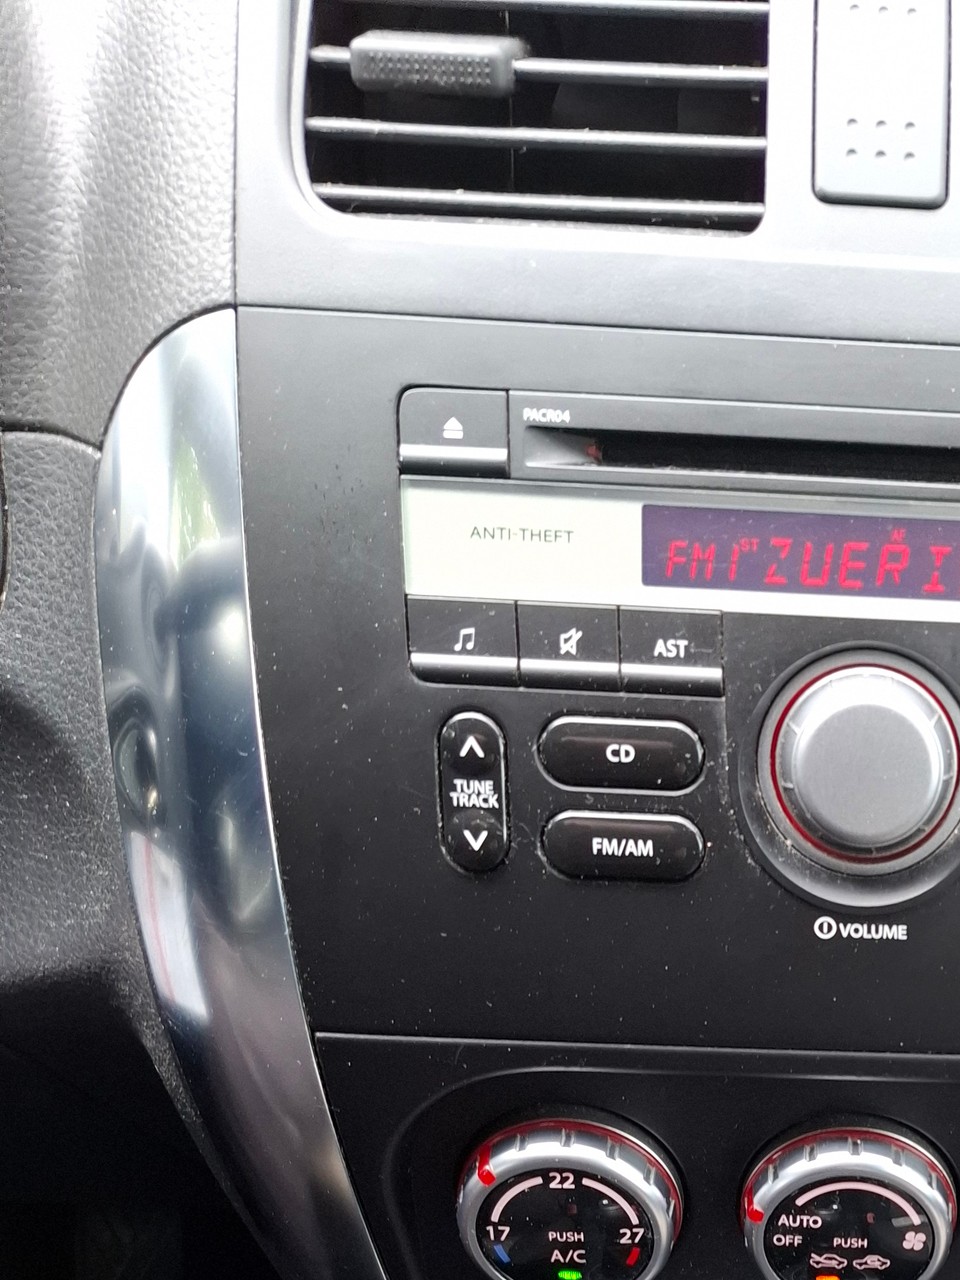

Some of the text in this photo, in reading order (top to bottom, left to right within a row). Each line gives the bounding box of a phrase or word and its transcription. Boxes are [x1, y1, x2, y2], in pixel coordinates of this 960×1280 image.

[522, 407, 571, 424] PACR04
[469, 526, 574, 544] ANTI-THEFT
[653, 638, 689, 659] AST
[605, 744, 636, 764] CD
[452, 778, 495, 796] TUNE
[449, 791, 499, 810] TRACK
[591, 837, 654, 858] FM/AM
[838, 923, 908, 941] VOLUME
[548, 1172, 576, 1190] 22
[777, 1213, 823, 1229] AUTO
[486, 1225, 511, 1242] 17
[548, 1230, 585, 1243] PUSH
[619, 1228, 646, 1245] 27
[772, 1234, 803, 1248] OFF
[832, 1237, 868, 1249] PUSH
[550, 1249, 587, 1264] A/C
